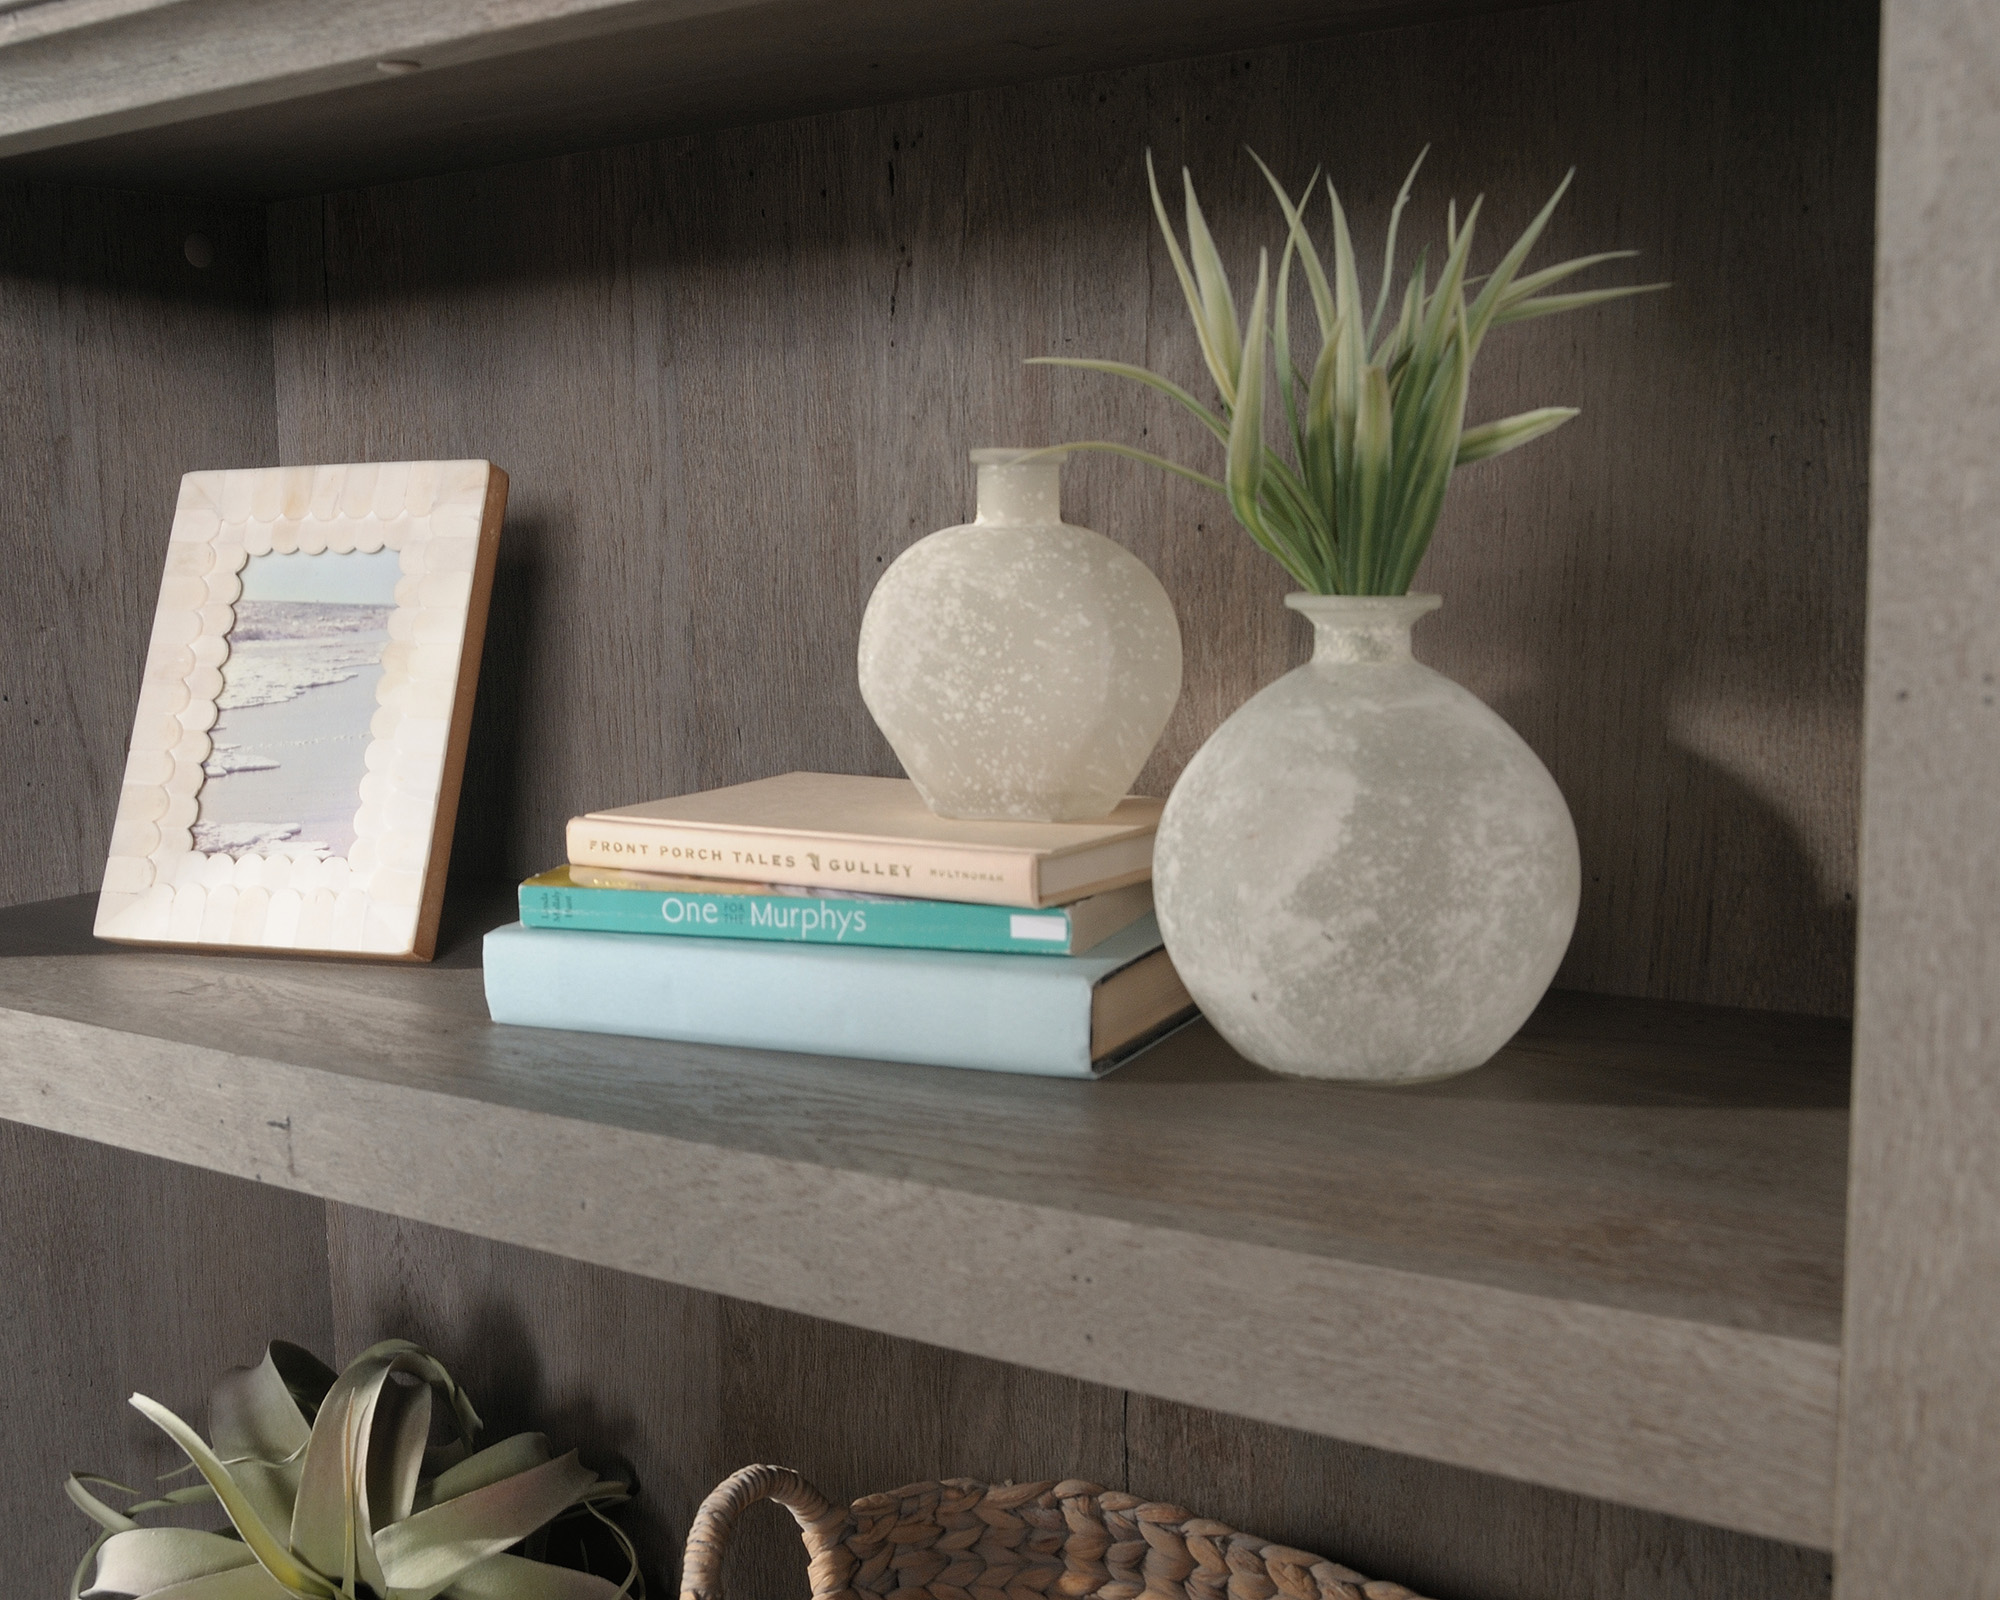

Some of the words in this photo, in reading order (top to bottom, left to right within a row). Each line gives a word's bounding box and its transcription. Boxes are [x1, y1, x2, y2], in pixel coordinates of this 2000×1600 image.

[590, 840, 648, 855] FRONT
[660, 845, 722, 861] PORCH
[733, 851, 796, 868] TALES
[829, 859, 912, 878] GULLEY
[662, 898, 718, 924] One
[751, 901, 866, 941] Murphys
